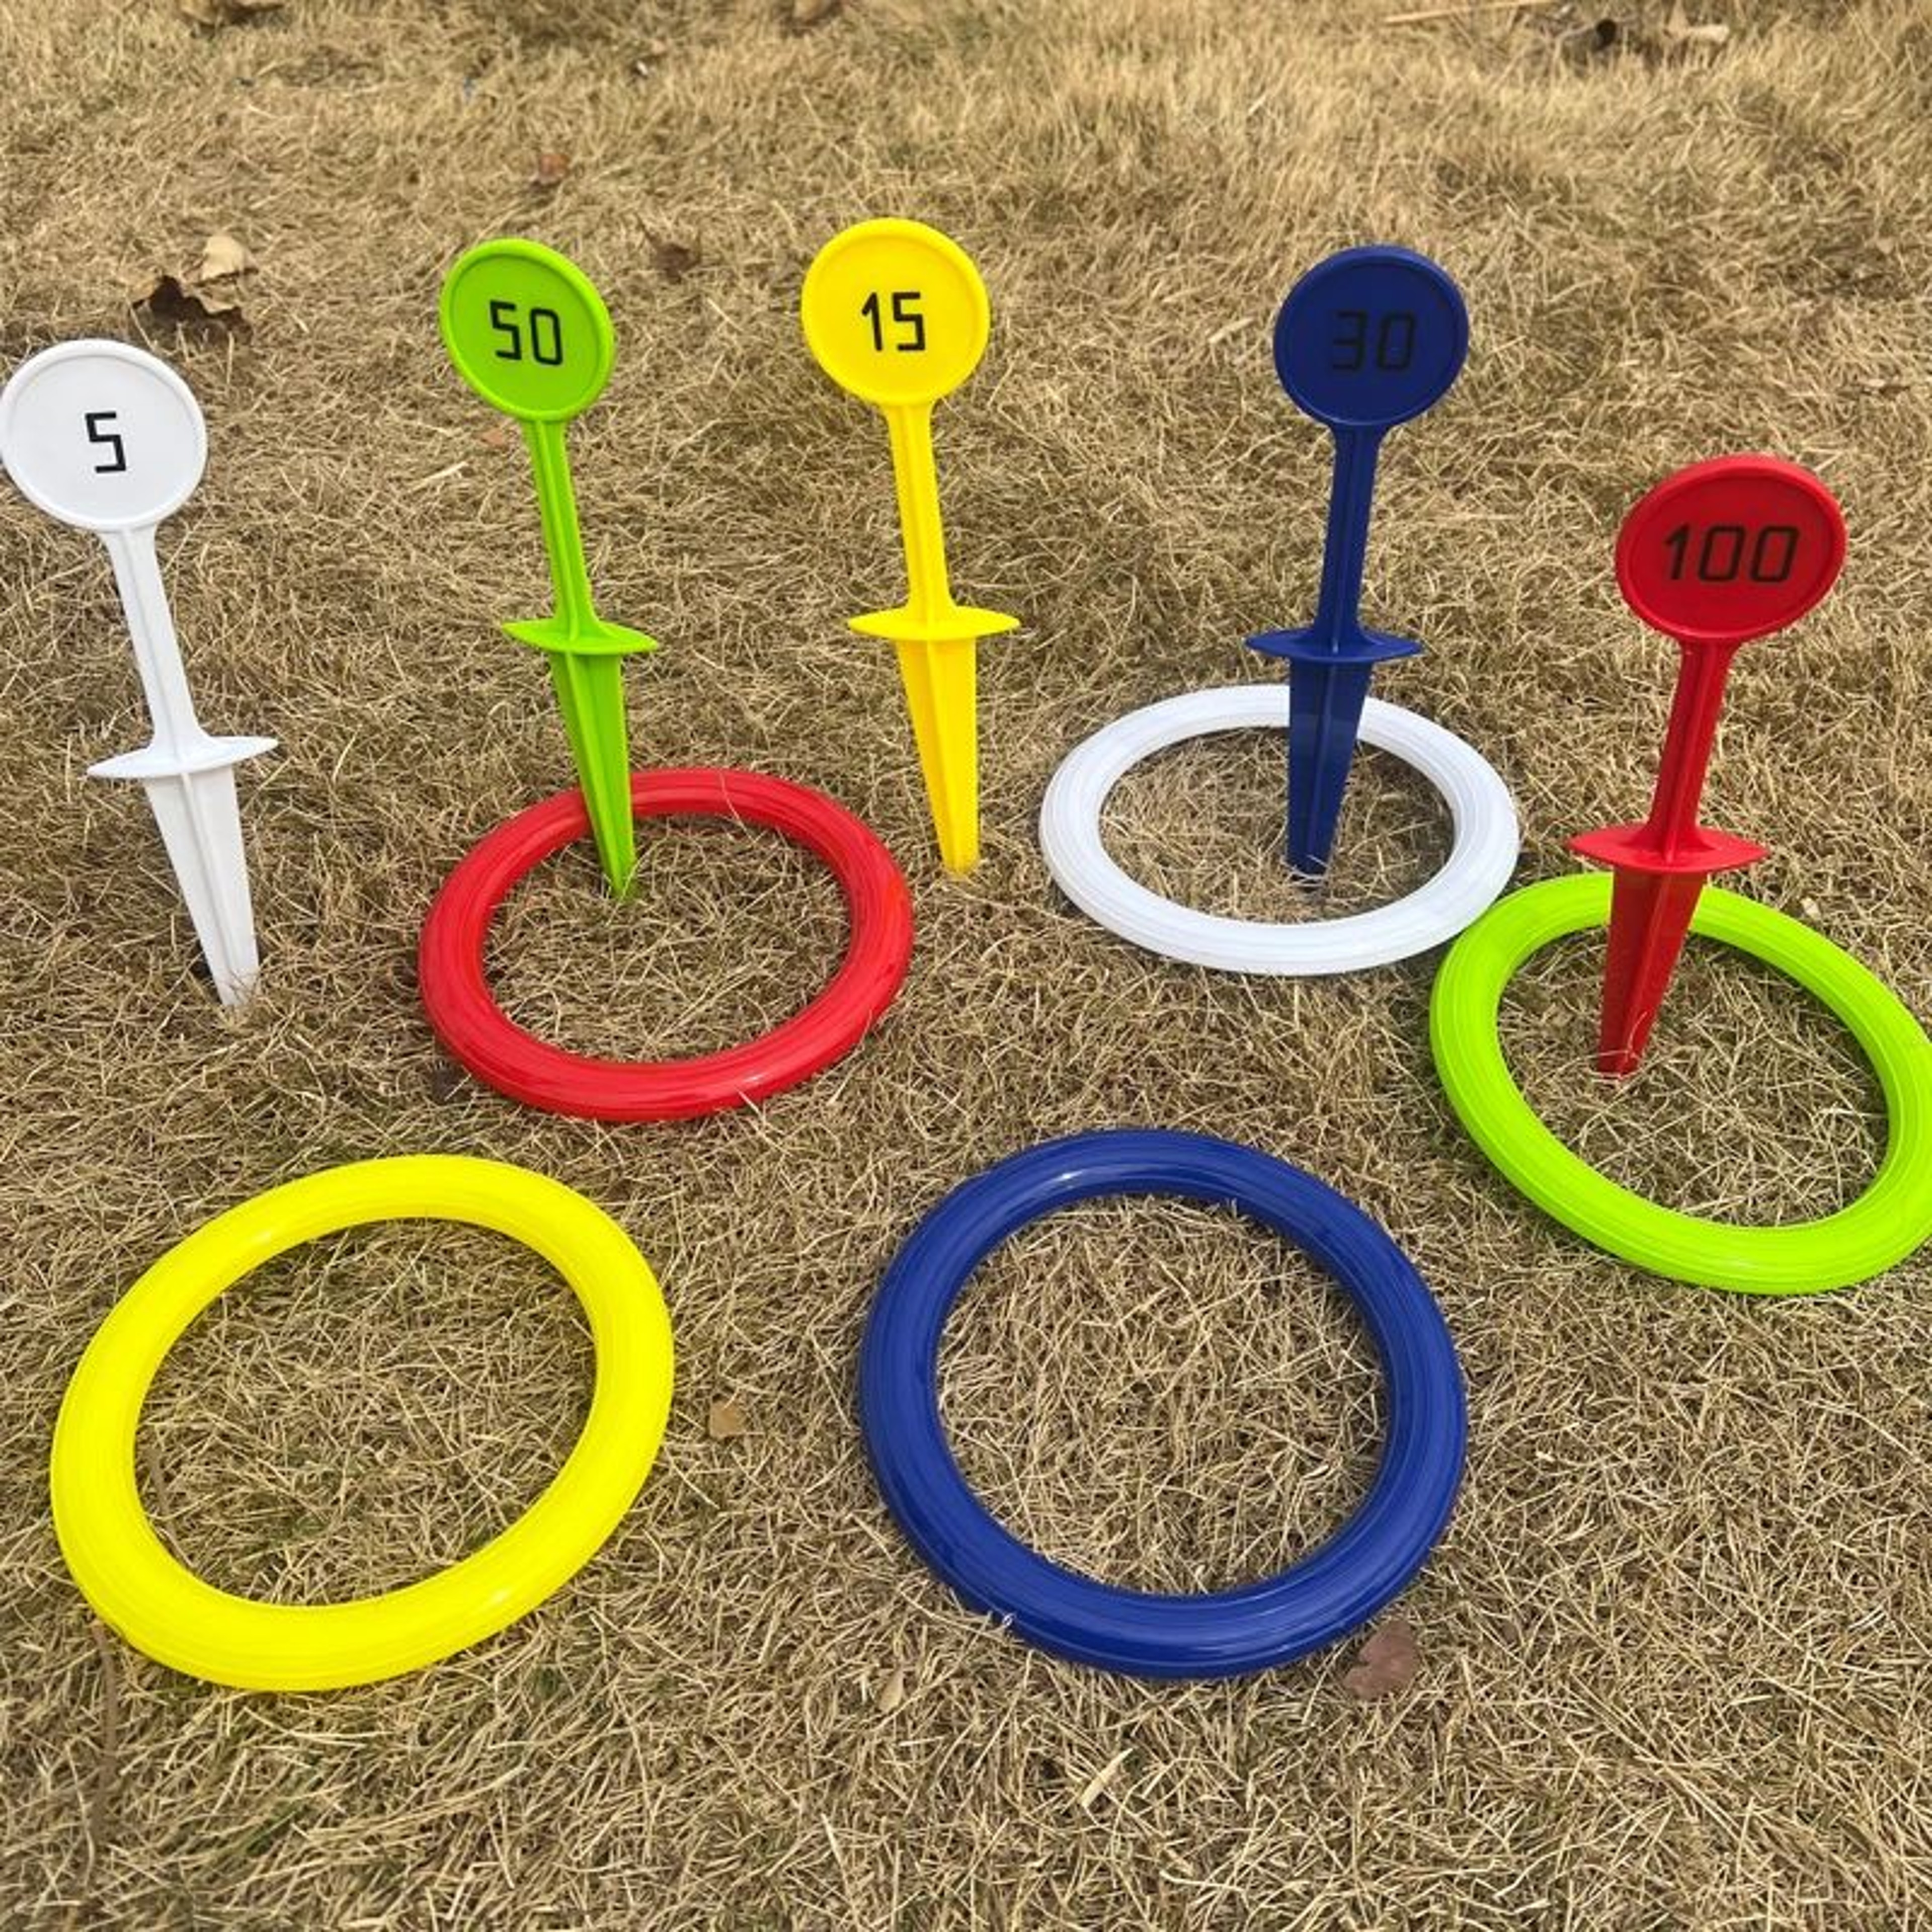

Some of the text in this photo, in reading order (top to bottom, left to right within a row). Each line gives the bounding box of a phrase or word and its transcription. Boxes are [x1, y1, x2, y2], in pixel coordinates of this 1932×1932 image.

[489, 299, 564, 367] 50
[861, 291, 926, 352] 15
[1332, 309, 1417, 374] 30
[84, 411, 127, 474] 5
[1663, 523, 1802, 585] 100
